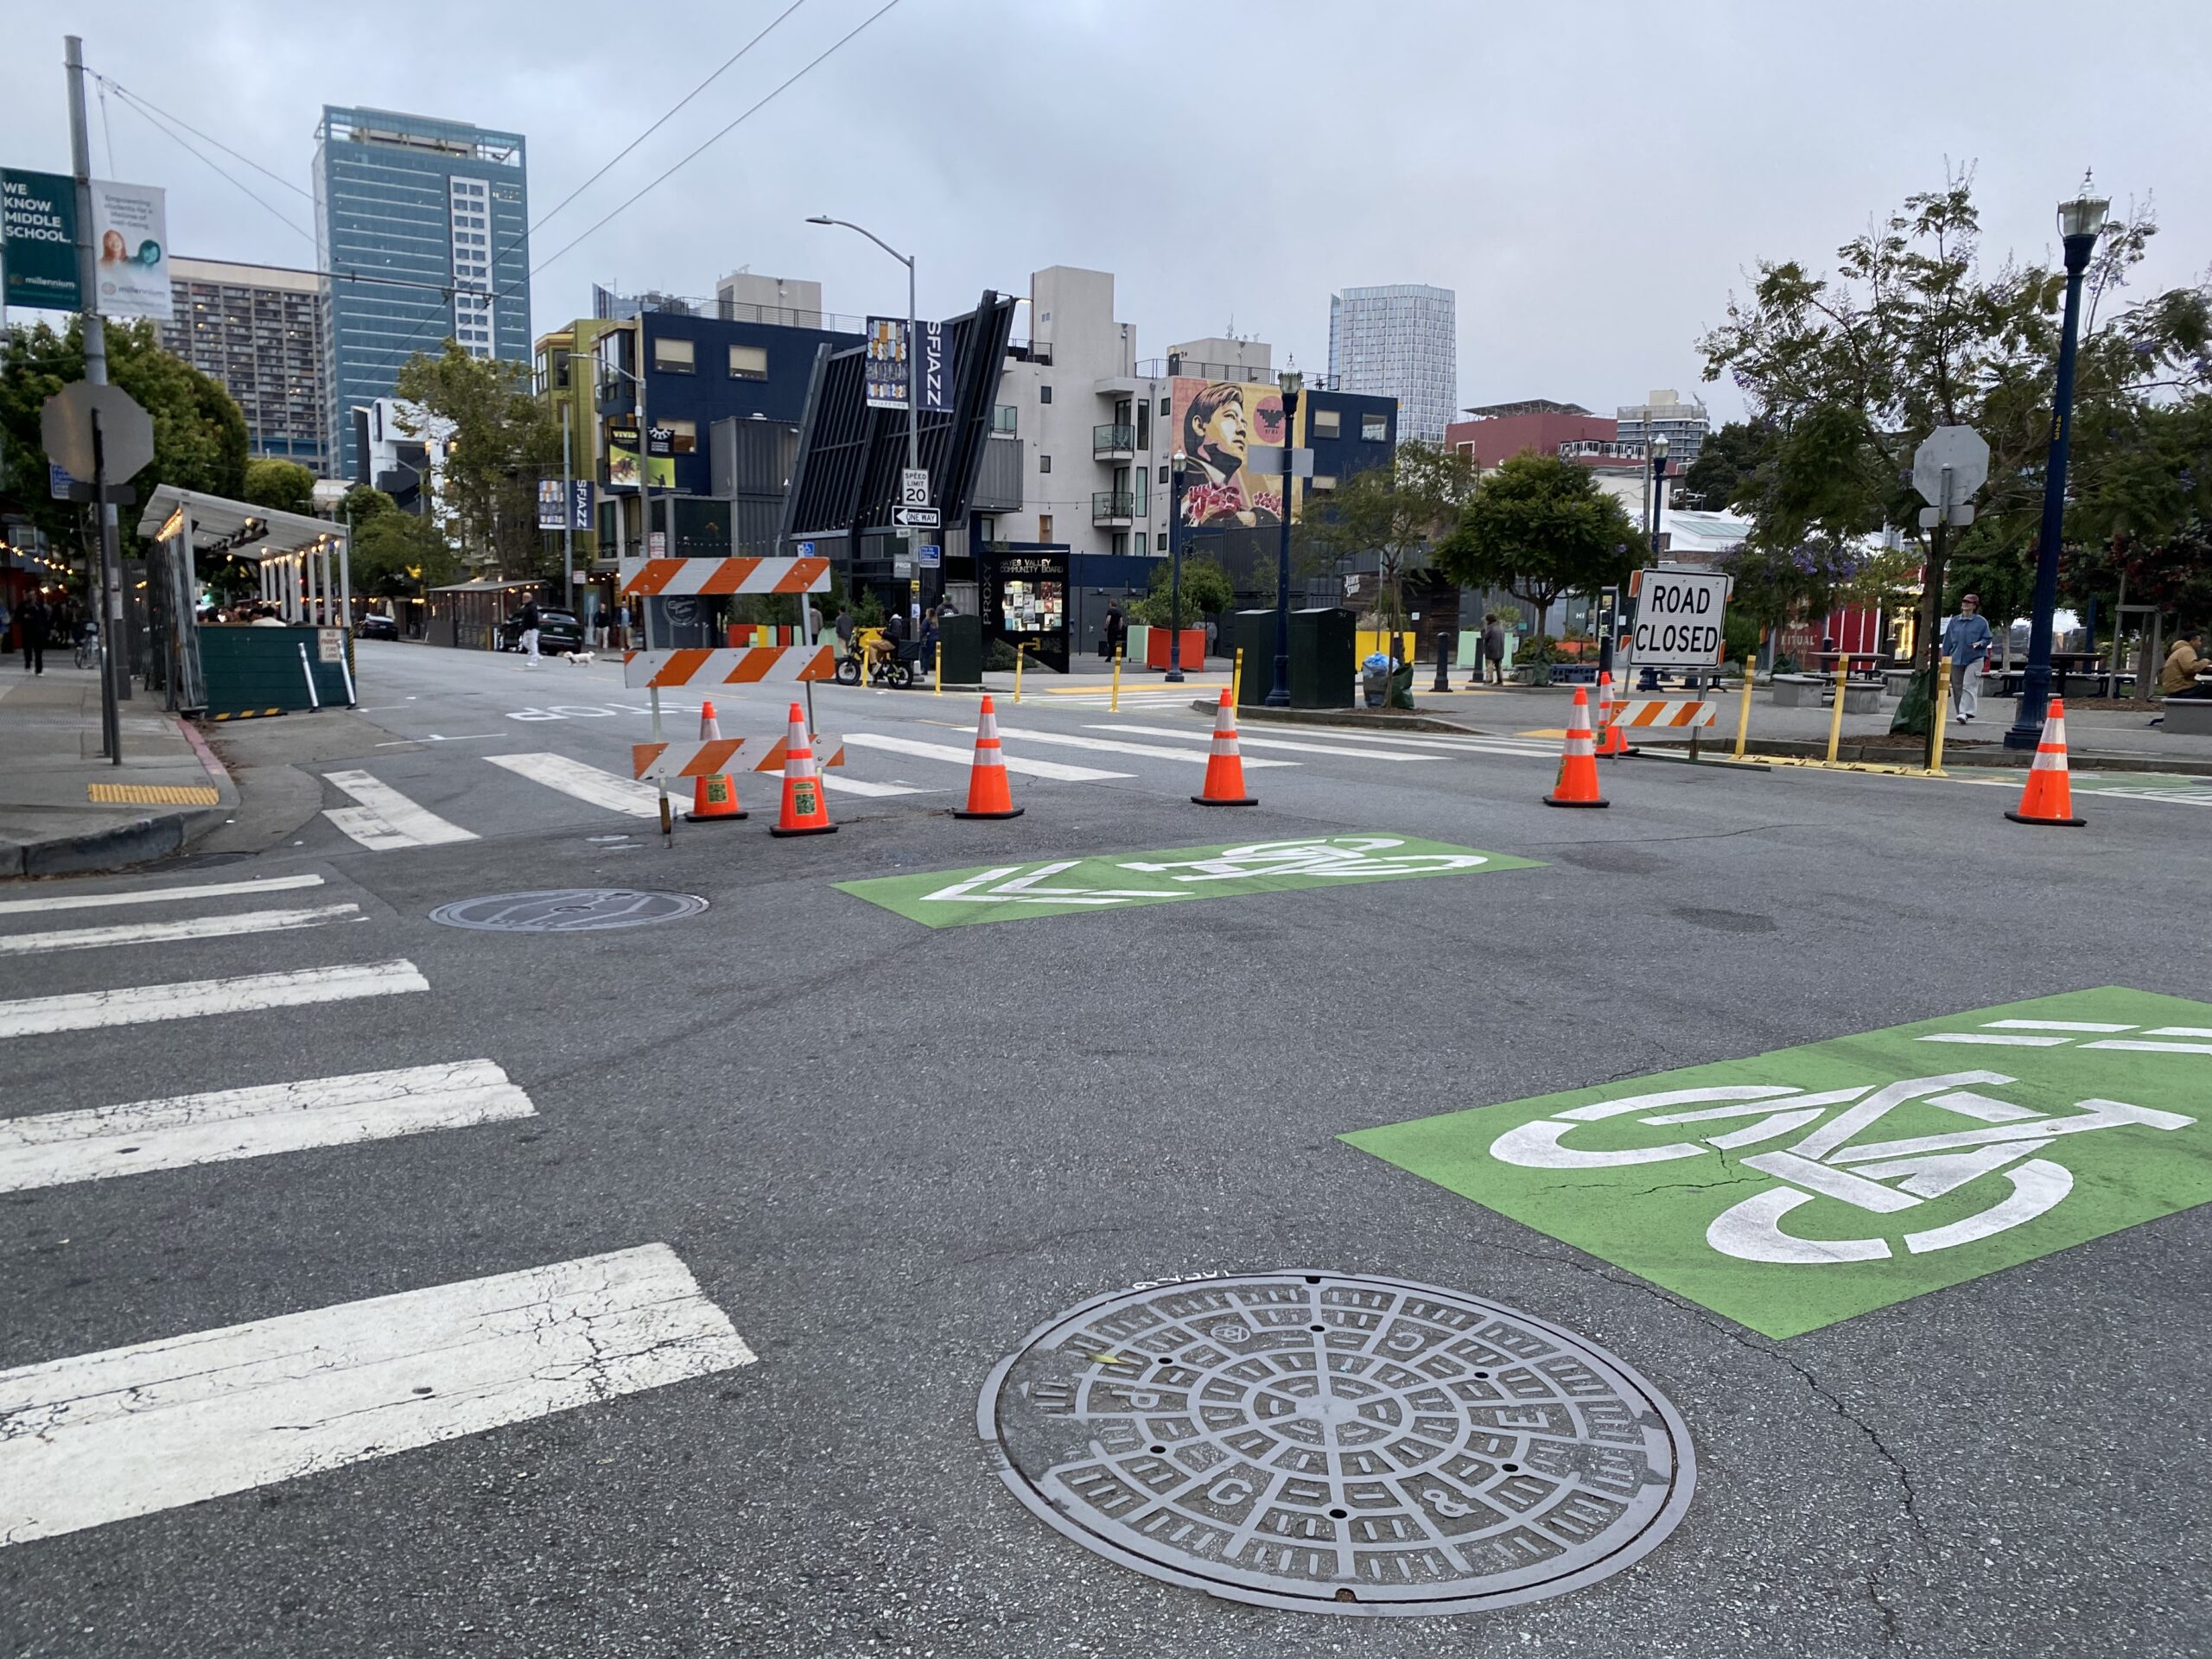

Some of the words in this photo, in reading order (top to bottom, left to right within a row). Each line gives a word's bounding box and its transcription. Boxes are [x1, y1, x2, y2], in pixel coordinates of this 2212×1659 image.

[3, 181, 27, 195] WE
[3, 196, 52, 212] KNOW
[4, 211, 61, 228] MIDDLE
[5, 226, 72, 244] SCHOOL.
[25, 276, 75, 289] millennium
[118, 286, 166, 296] millennium
[926, 321, 941, 406] SFJAZZ
[906, 488, 926, 502] 20
[576, 479, 588, 528] SFJAZZ
[906, 512, 919, 521] ONE
[1652, 586, 1710, 613] ROAD
[1636, 624, 1718, 652] CLOSED
